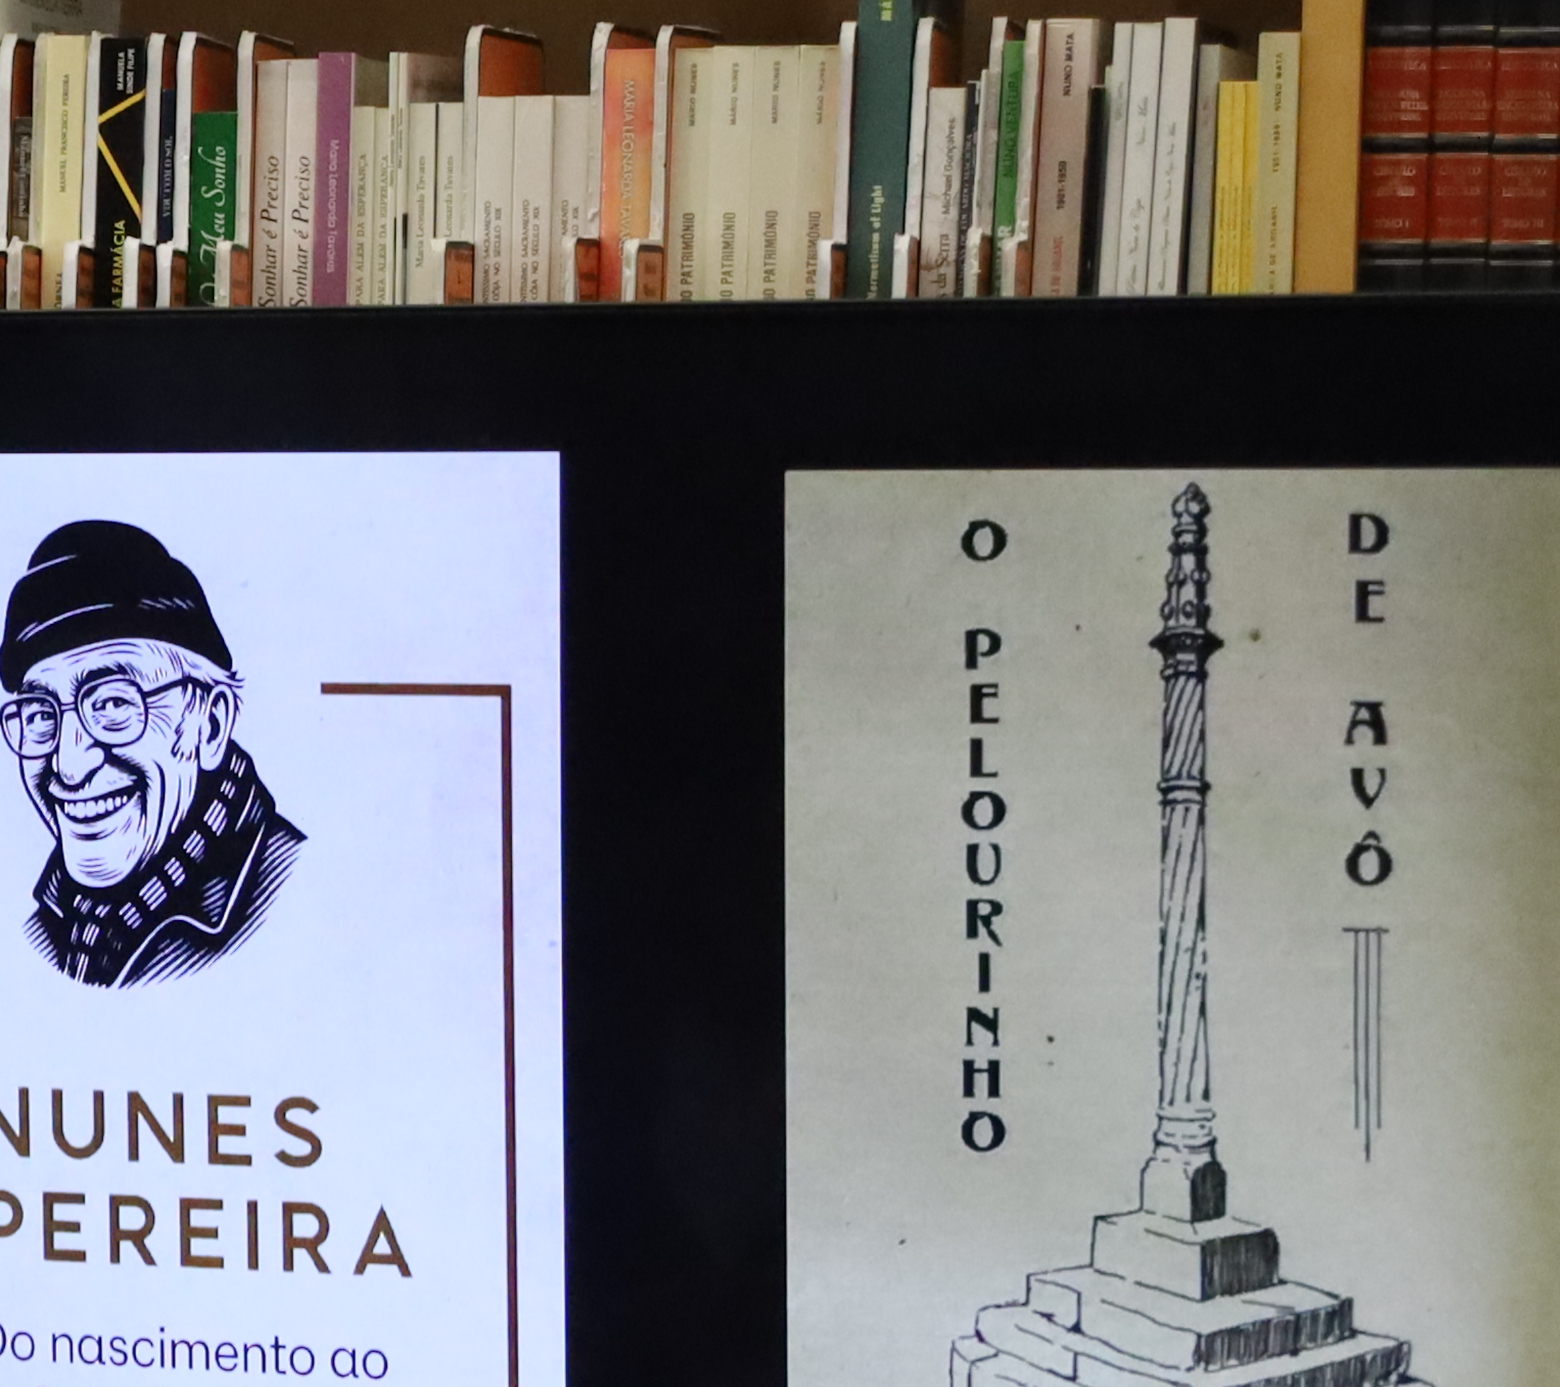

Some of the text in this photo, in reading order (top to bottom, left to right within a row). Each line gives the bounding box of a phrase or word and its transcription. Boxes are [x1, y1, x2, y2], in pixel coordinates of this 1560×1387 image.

[260, 156, 279, 223] Preciso
[258, 245, 278, 307] Sonhar
[1344, 512, 1393, 886] DE AVÔ
[960, 519, 1007, 1152] O PELOURINHO
[51, 1326, 316, 1378] nascimento
[331, 1341, 390, 1380] ao
